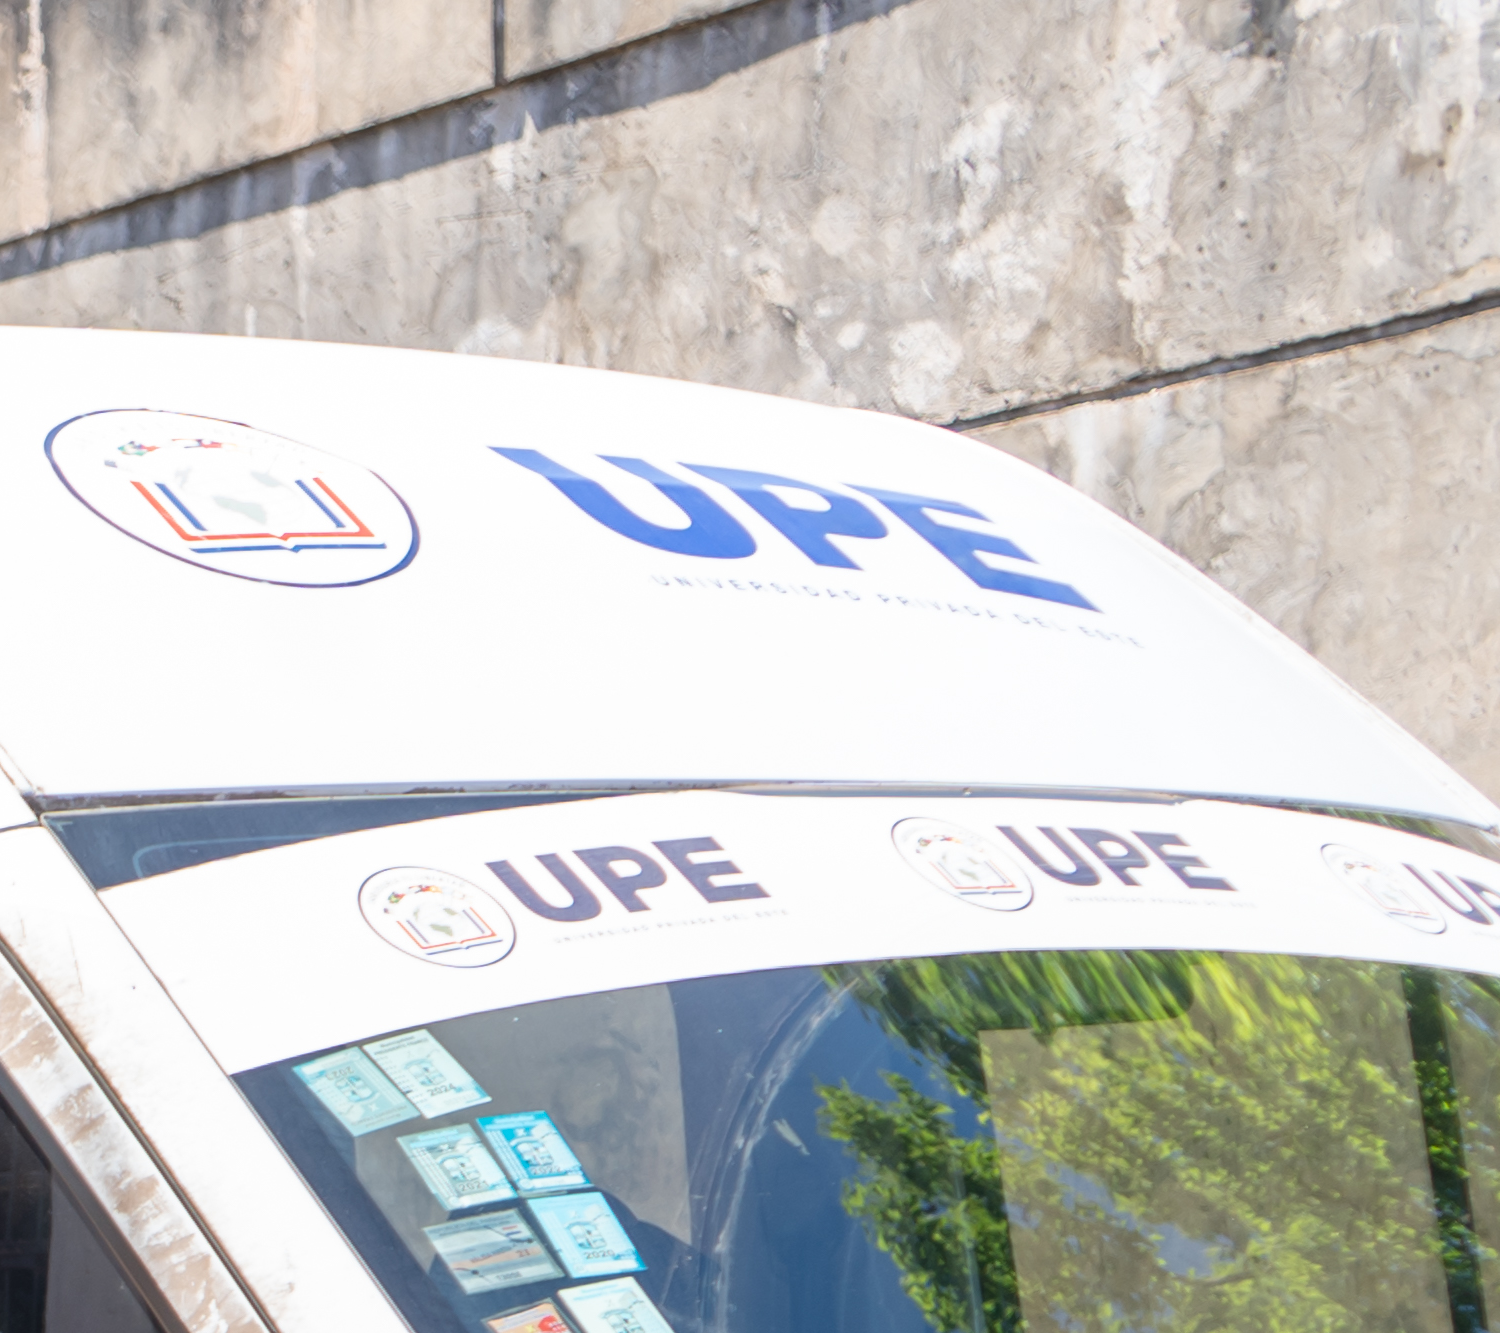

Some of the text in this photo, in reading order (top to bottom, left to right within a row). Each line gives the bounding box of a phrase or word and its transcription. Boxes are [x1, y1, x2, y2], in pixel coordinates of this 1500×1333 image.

[487, 444, 1103, 613] UPE
[485, 836, 772, 923] UPE
[996, 825, 1238, 892] UPE
